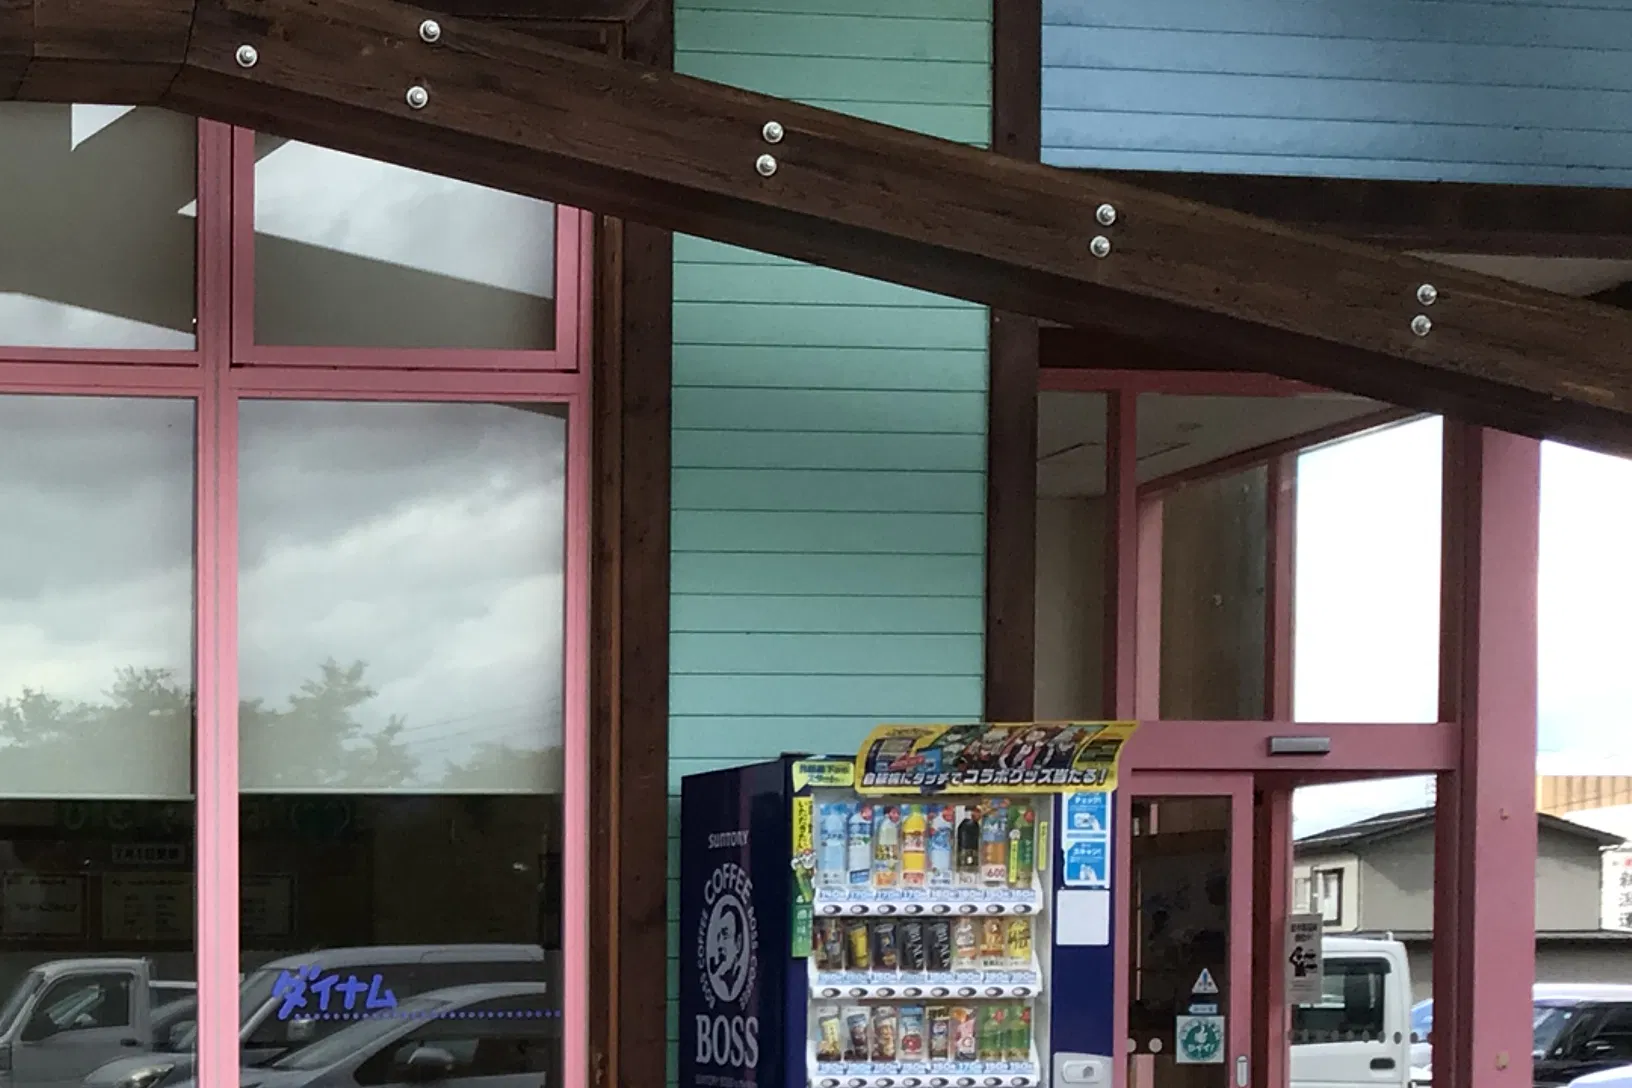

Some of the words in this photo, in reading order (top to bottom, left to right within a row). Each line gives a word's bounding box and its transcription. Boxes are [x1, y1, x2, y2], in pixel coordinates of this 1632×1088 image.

[708, 829, 749, 849] SUNTORY
[704, 862, 754, 905] COFFEE
[272, 964, 398, 1021] ダイナム
[695, 1014, 759, 1069] BOSS
